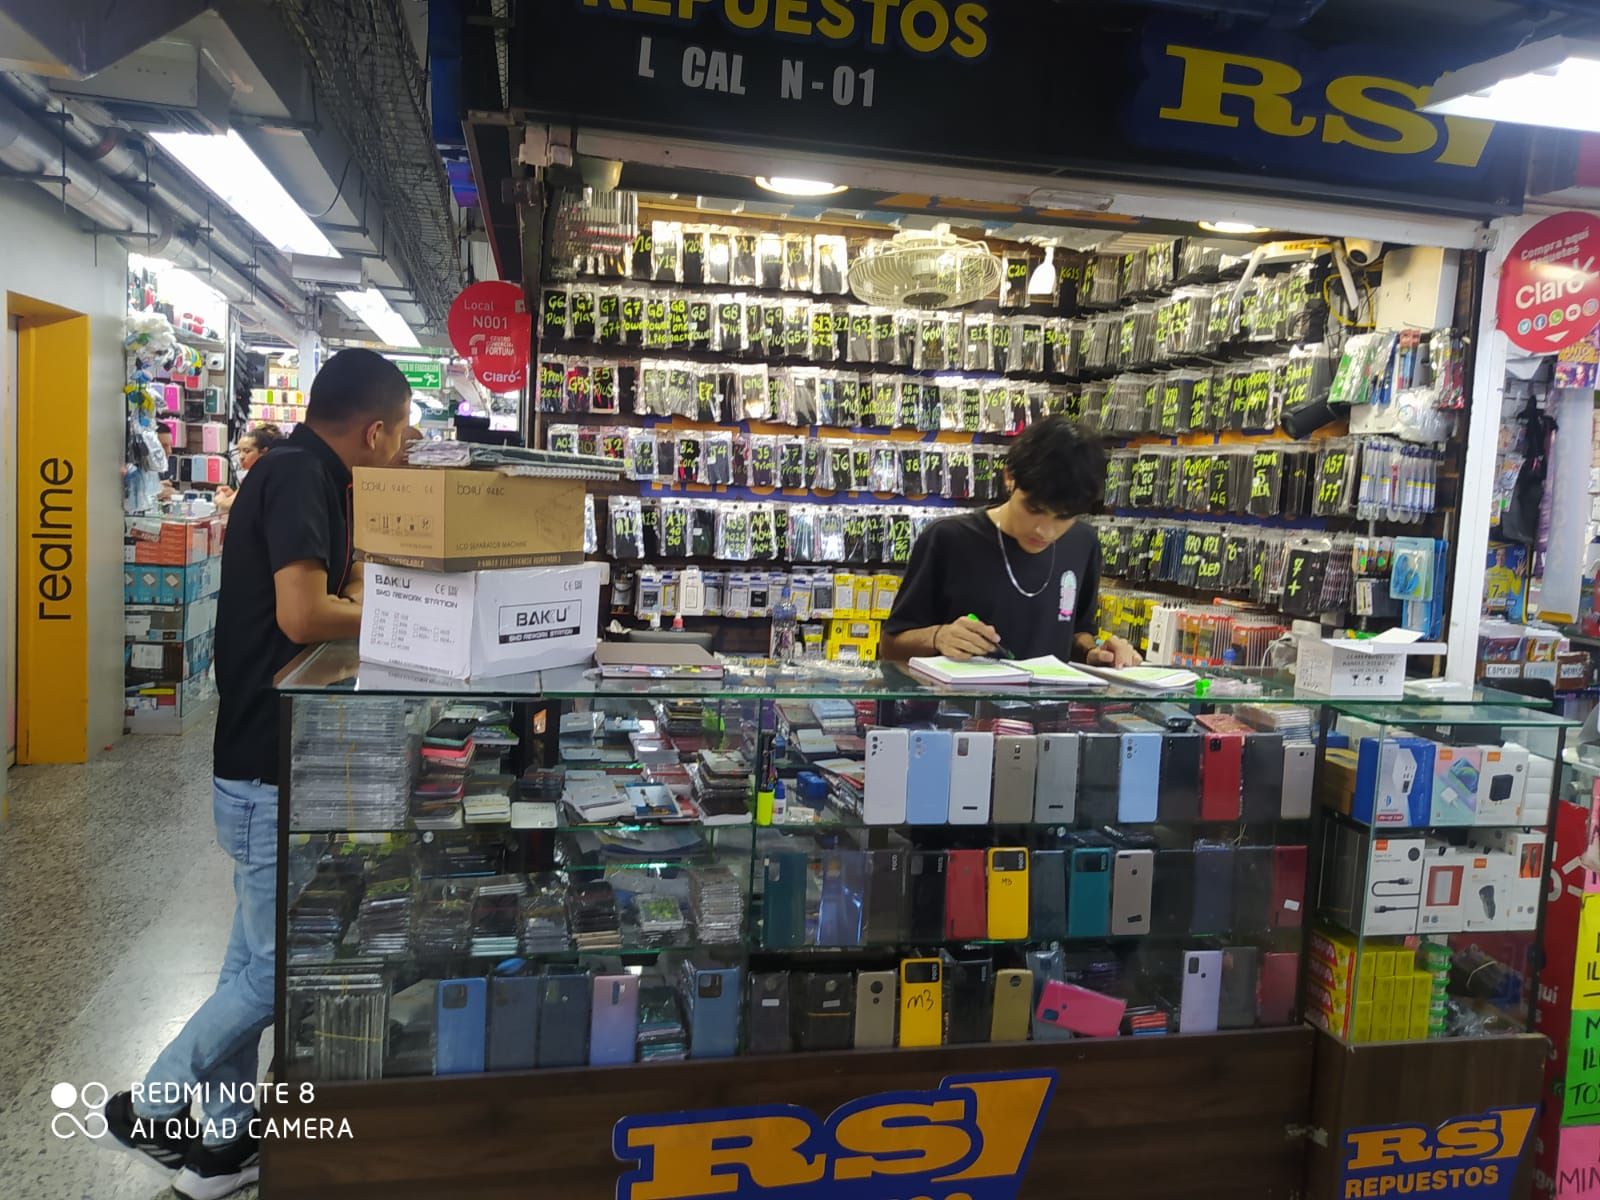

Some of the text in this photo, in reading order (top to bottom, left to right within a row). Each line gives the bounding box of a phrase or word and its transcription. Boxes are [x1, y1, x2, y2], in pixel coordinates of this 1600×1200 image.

[582, 0, 988, 58] UESTOS
[1521, 240, 1562, 261] Compra
[1007, 263, 1026, 279] C20
[1516, 270, 1588, 309] Claro
[464, 300, 494, 311] Local
[548, 296, 565, 309] G6
[576, 296, 593, 311] G7
[600, 299, 617, 314] G7
[623, 301, 641, 317] G7
[647, 303, 664, 318] G8
[670, 300, 686, 312] G8
[546, 312, 567, 326] Play
[690, 304, 707, 321] G8
[722, 304, 738, 320] G8
[750, 304, 758, 321] 9
[765, 307, 782, 326] G9
[473, 315, 508, 329] N001
[766, 331, 785, 347] Plus
[486, 346, 515, 356] FORTUNA
[482, 370, 519, 383] Claro
[843, 383, 855, 399] A6
[877, 387, 892, 402] A7
[832, 452, 849, 471] J6
[1323, 454, 1345, 474] A57
[1214, 473, 1225, 489] 7
[1210, 491, 1226, 506] 4G
[1318, 480, 1339, 503] A77
[32, 458, 74, 621] realme
[375, 574, 411, 589] BAKU
[424, 597, 458, 609] STATION
[516, 607, 567, 627] BAKU
[1569, 1082, 1600, 1107] TO
[1344, 1165, 1499, 1200] REPUESTOS
